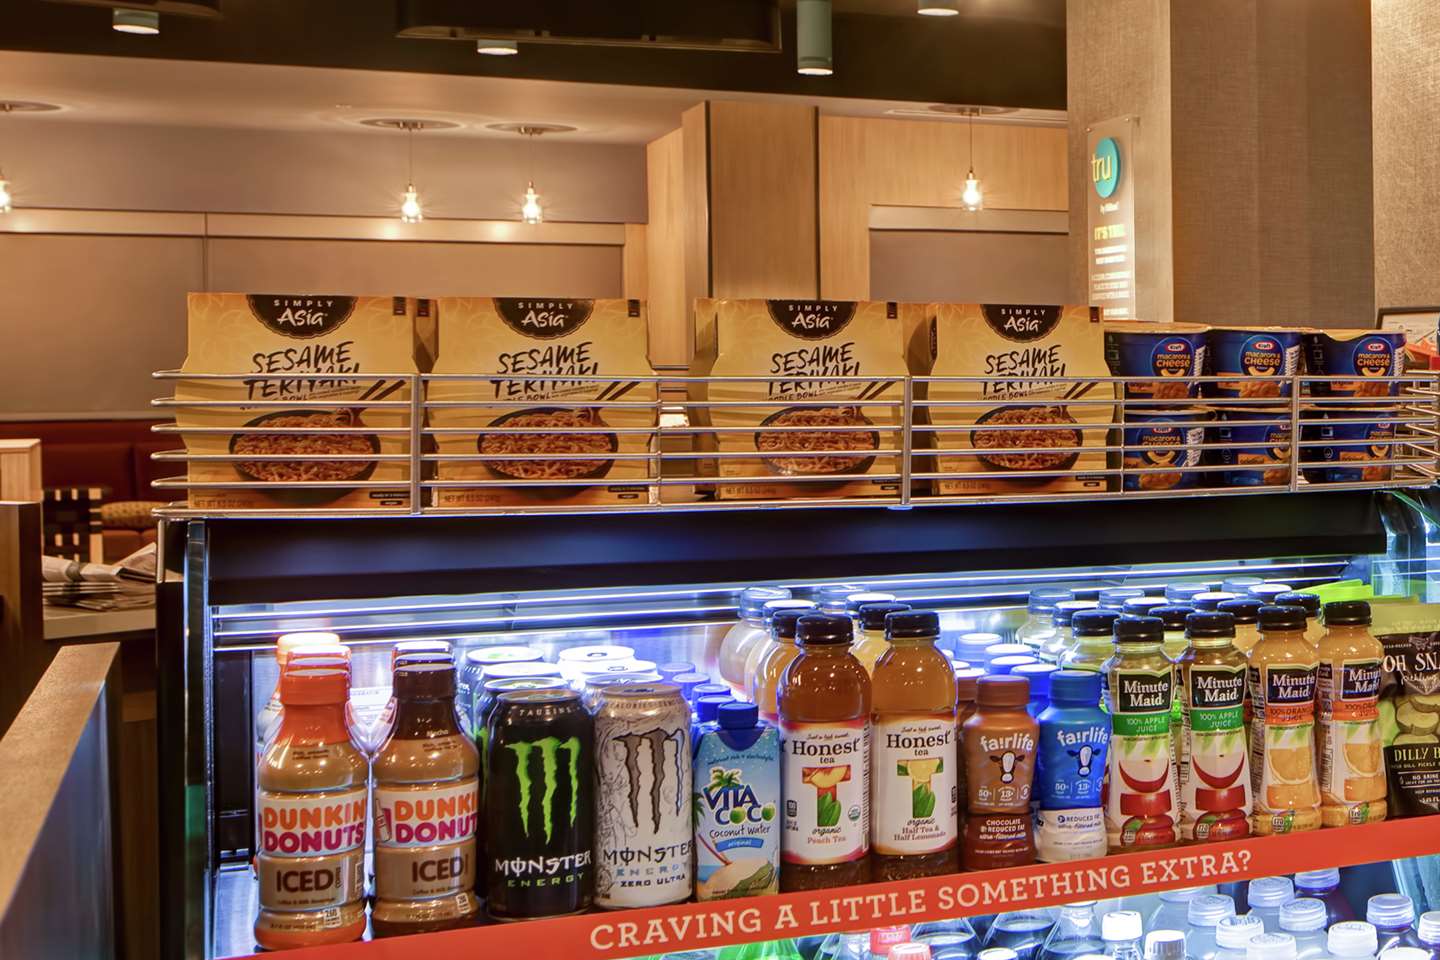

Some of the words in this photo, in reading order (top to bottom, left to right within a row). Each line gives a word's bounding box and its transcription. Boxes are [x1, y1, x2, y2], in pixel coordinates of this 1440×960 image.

[1091, 153, 1112, 182] tru
[274, 299, 334, 308] SIMPLY
[518, 301, 574, 310] SIMPLY
[788, 304, 839, 313] SIMPLY
[1001, 307, 1047, 316] SIMPLY
[277, 308, 328, 327] Asia
[521, 310, 568, 329] Asia
[791, 312, 834, 329] Asia
[1003, 316, 1043, 332] Asia
[1258, 342, 1272, 350] Kraft
[251, 340, 354, 375] SESAME
[496, 341, 593, 375] SESAME
[770, 342, 856, 373] SESAME
[985, 344, 1061, 375] SESAME
[1383, 654, 1406, 673] OH
[1124, 680, 1169, 694] Minute
[1196, 676, 1243, 690] Minute
[1272, 674, 1315, 687] Minute
[1130, 693, 1164, 707] Maid
[1204, 688, 1239, 702] Maid
[1278, 686, 1310, 699] Maid
[1144, 717, 1165, 725] APPLE
[1219, 711, 1239, 720] APPLE
[1210, 720, 1232, 728] JUICE
[791, 738, 860, 757] Honest
[886, 730, 951, 749] Honest
[1394, 747, 1432, 763] DILLY
[703, 784, 762, 811] VITA
[394, 792, 478, 822] DUNKI
[715, 803, 776, 825] COCO
[395, 813, 478, 845] DONUT
[902, 826, 918, 834] Half
[986, 818, 1021, 826] CHOCOLATE
[987, 825, 1017, 833] REDUCED
[264, 824, 365, 853] DONUTS
[893, 833, 911, 841] Half
[912, 831, 947, 840] Lemonade
[412, 854, 465, 883] ICED
[495, 850, 592, 877] MONSTER
[276, 868, 334, 893] ICED
[507, 872, 584, 888] ENERGY
[620, 878, 652, 888] ZERO
[656, 874, 686, 886] ULTRA
[589, 908, 763, 951] CRAVING
[774, 903, 800, 930] A
[809, 890, 928, 925] LITTLE
[937, 863, 1131, 911] SOMETHING
[1140, 849, 1254, 885] EXTRA?
